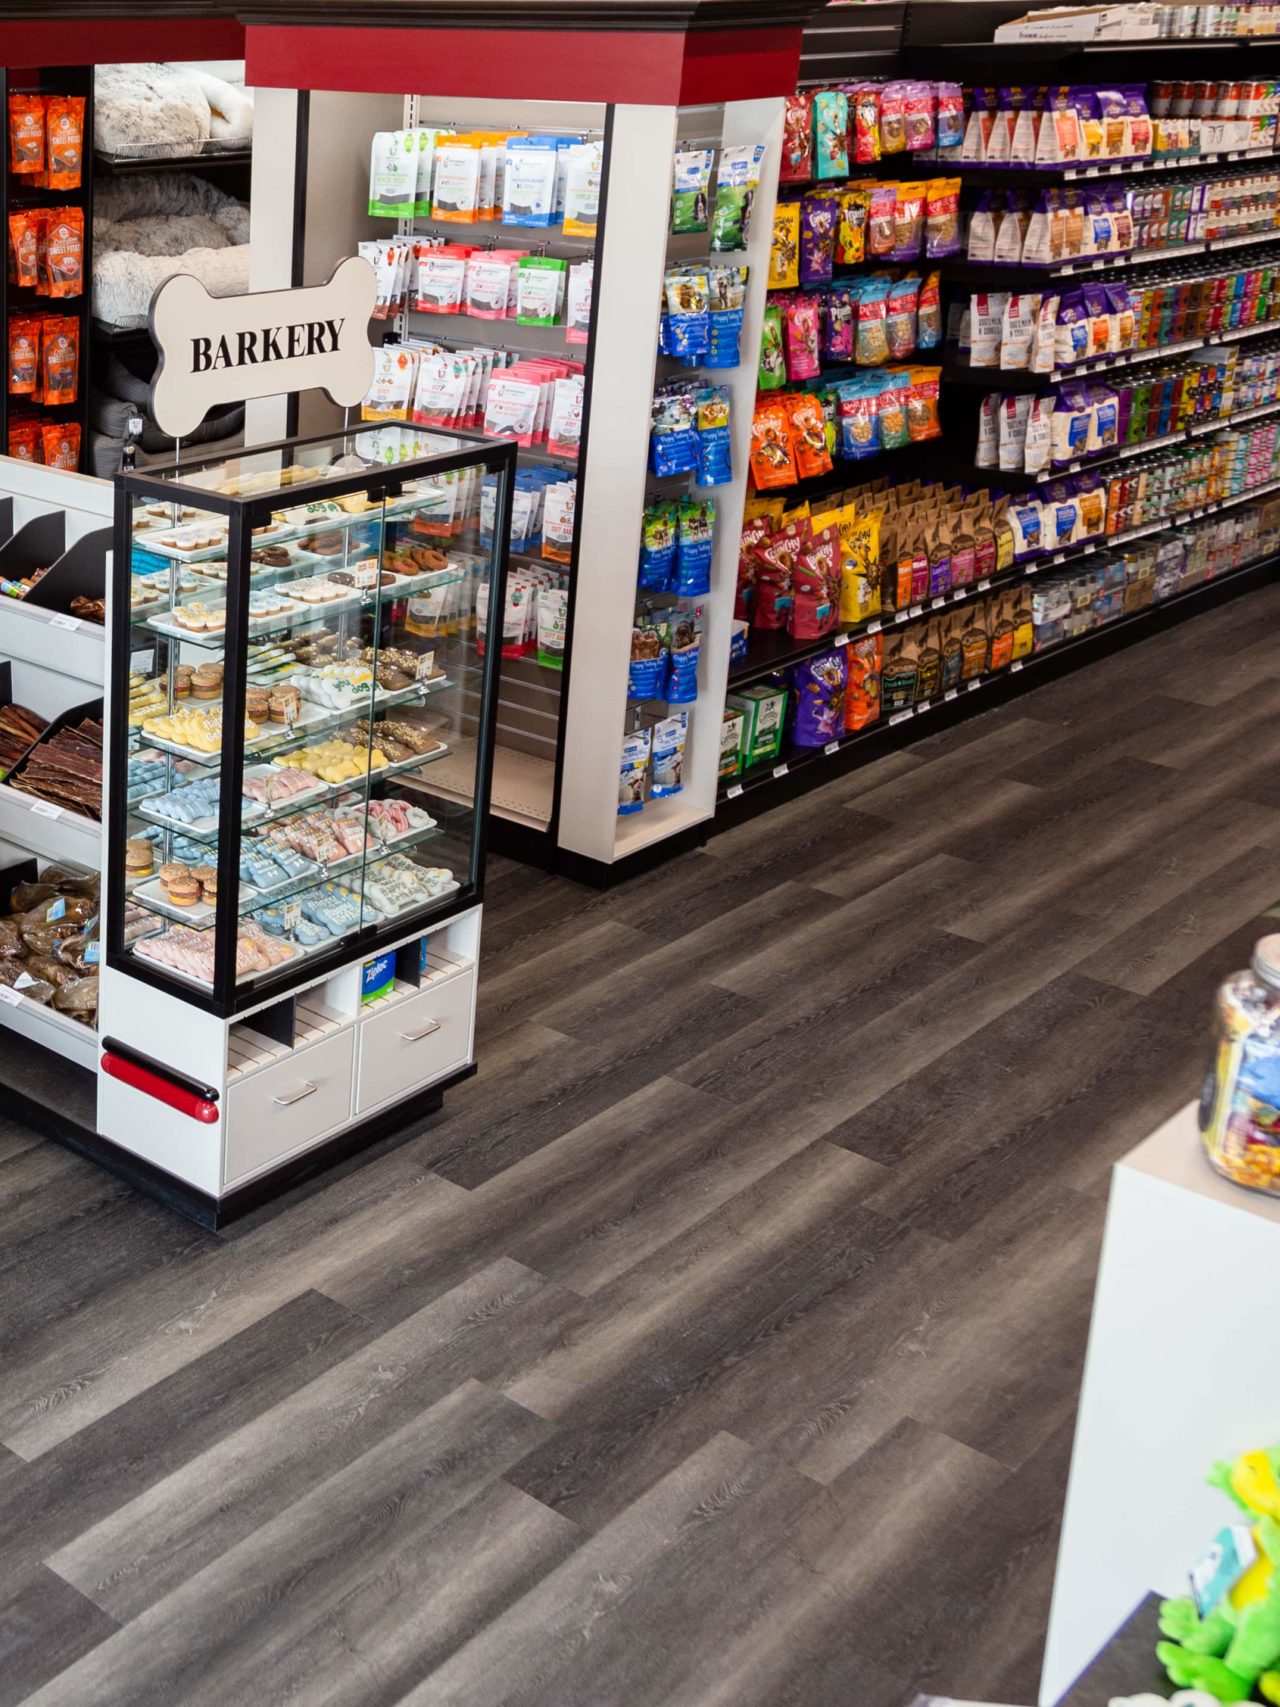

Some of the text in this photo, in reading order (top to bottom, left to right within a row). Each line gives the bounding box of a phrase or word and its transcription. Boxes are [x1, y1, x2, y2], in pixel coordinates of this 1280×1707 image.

[190, 318, 346, 374] BARKERY
[333, 680, 371, 694] you dog
[366, 959, 388, 984] Ziploc
